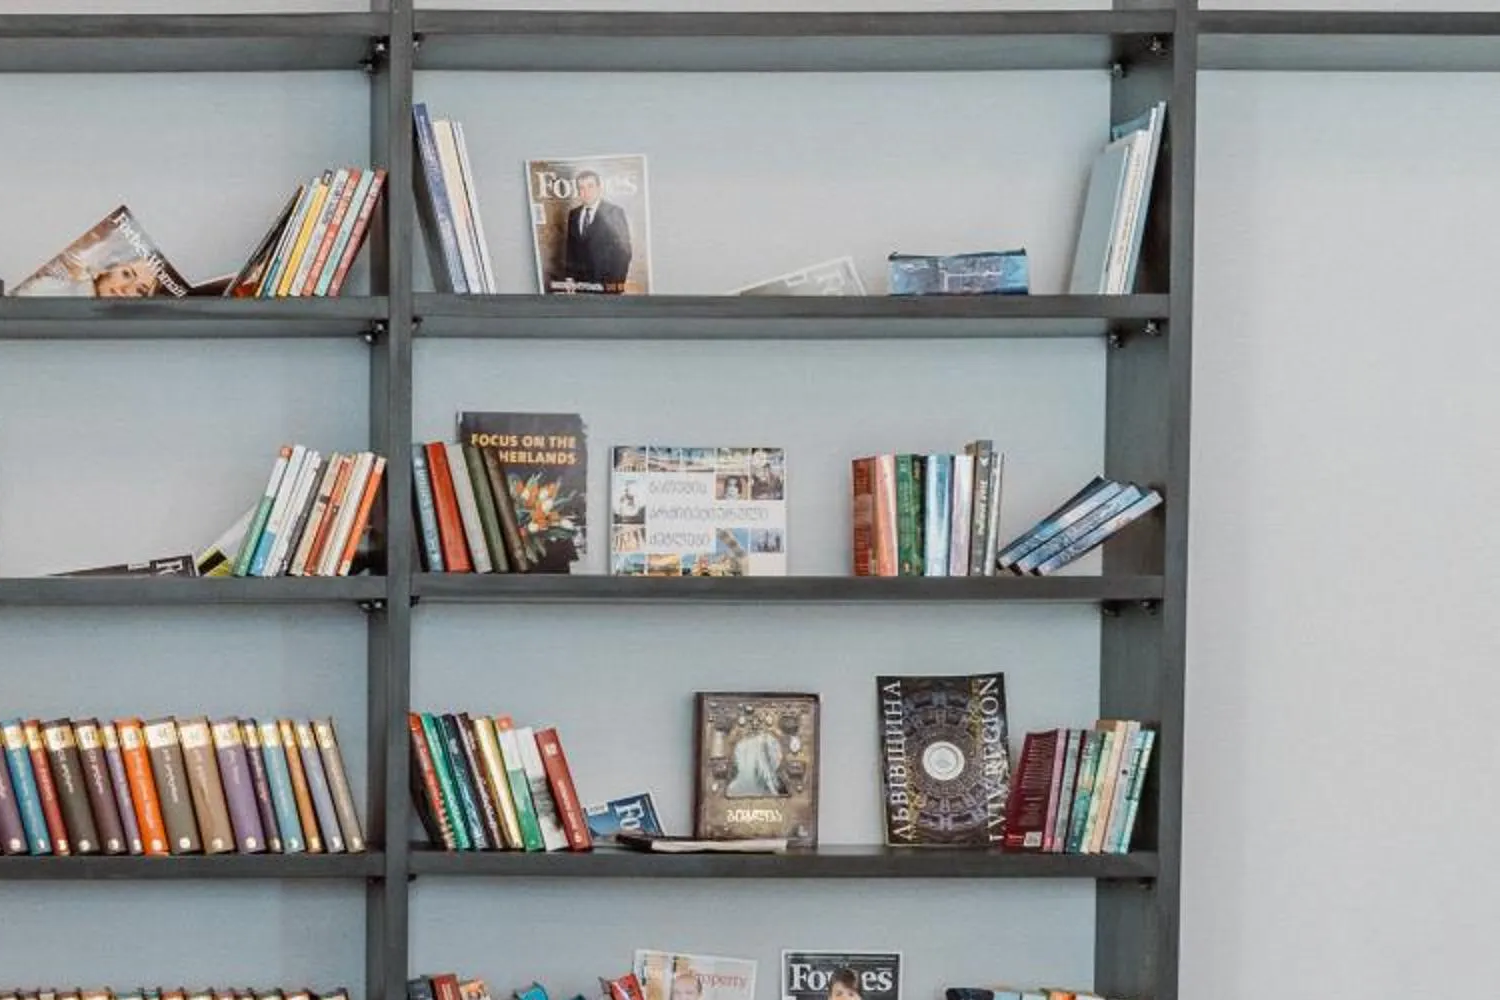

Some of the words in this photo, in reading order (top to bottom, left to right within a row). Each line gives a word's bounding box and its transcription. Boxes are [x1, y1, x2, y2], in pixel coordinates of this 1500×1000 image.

[535, 171, 638, 200] Fores
[471, 433, 517, 447] FOCUS
[522, 435, 545, 447] ON
[549, 435, 576, 448] THE
[499, 451, 576, 465] HERLANDS
[788, 963, 893, 992] Foes
